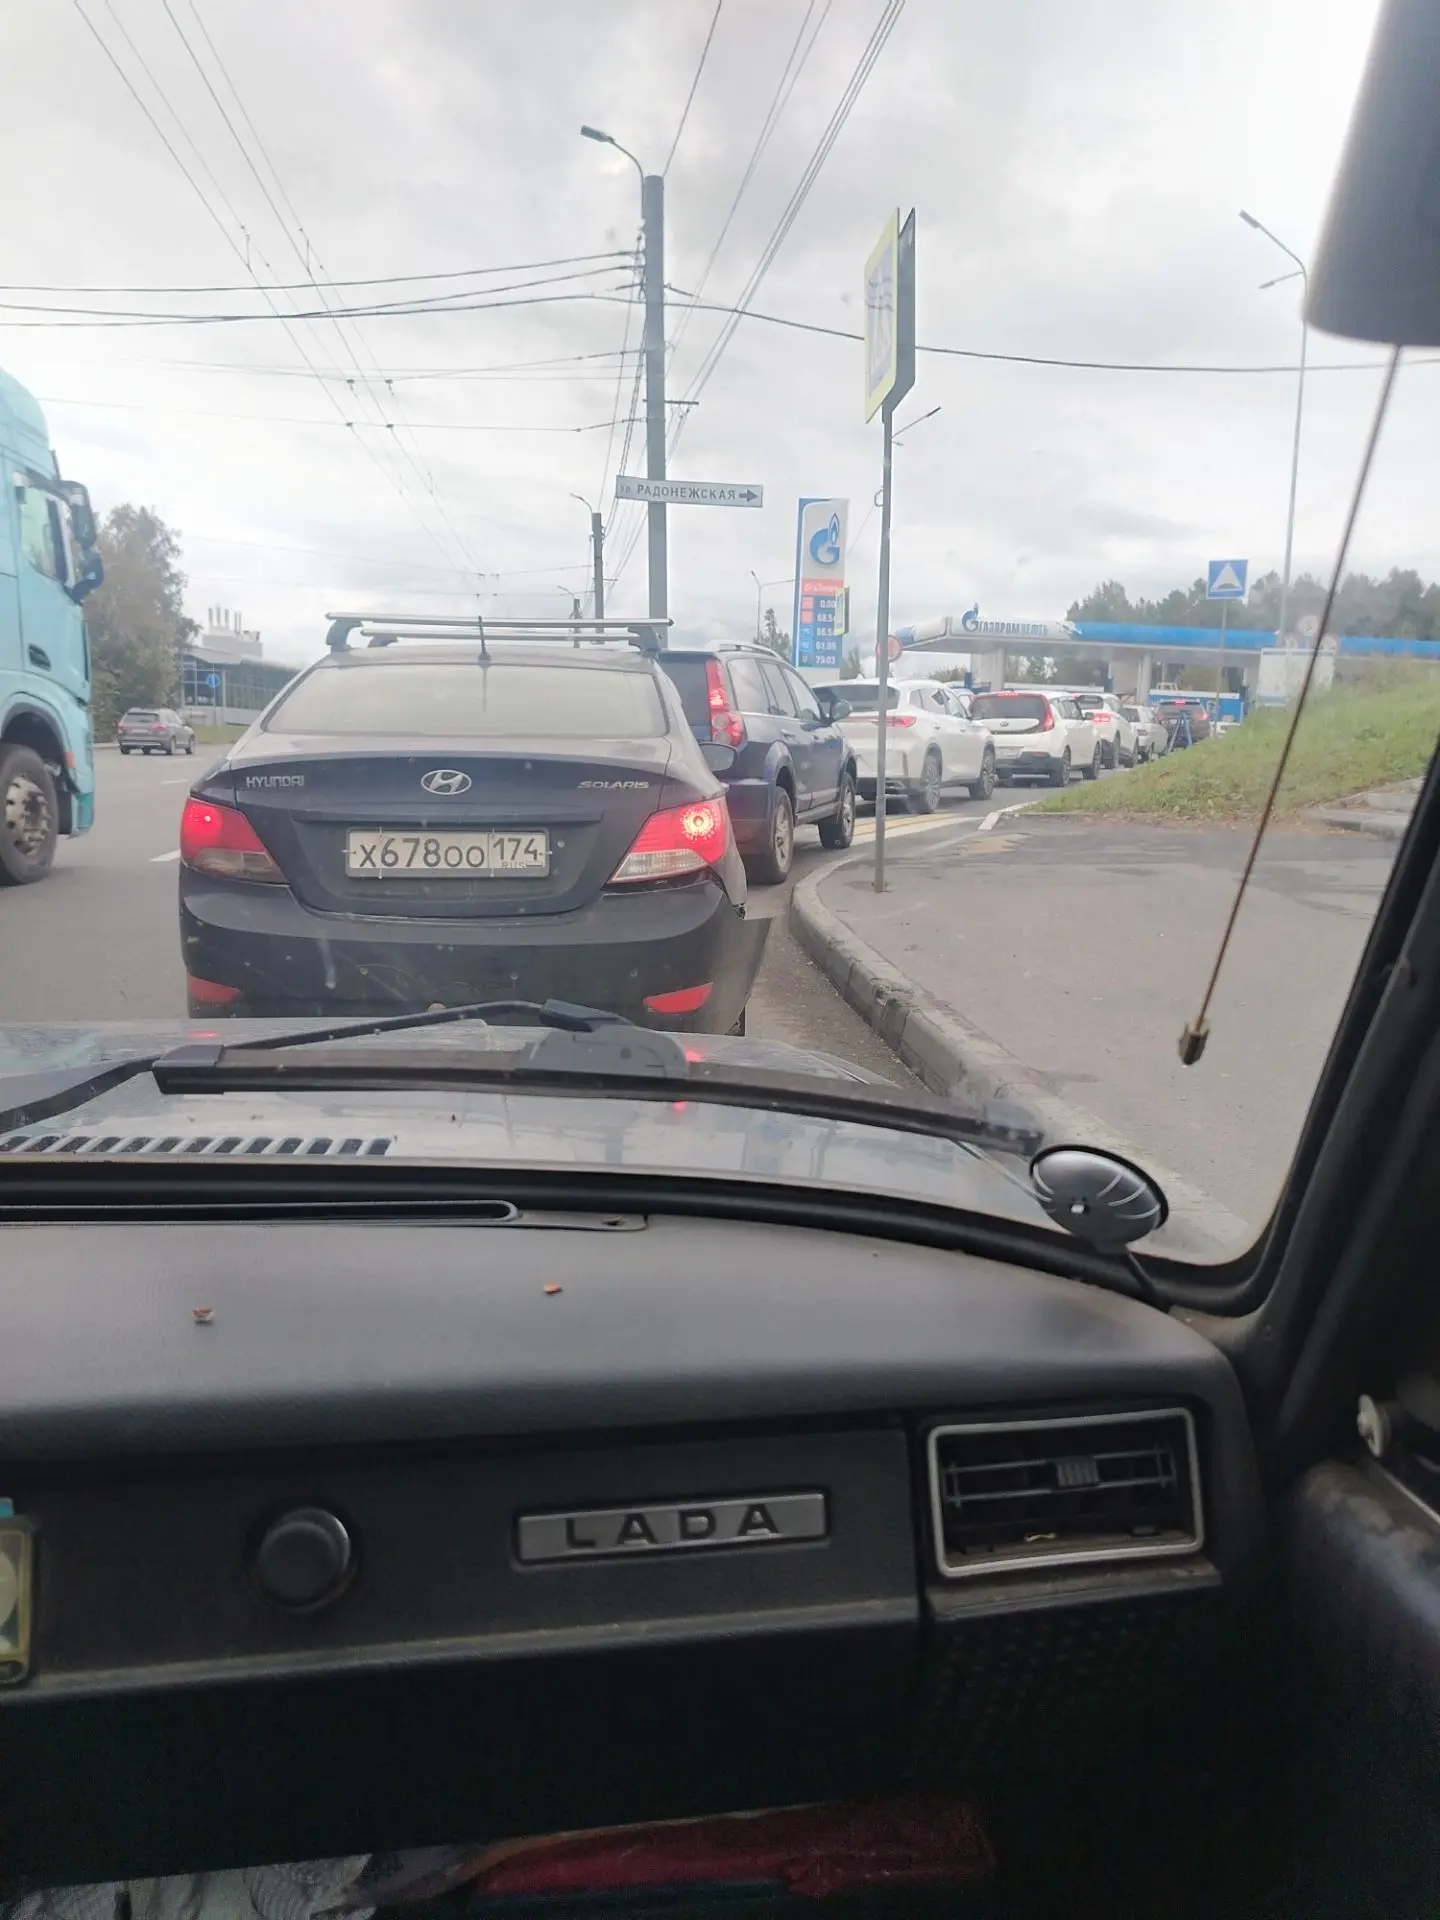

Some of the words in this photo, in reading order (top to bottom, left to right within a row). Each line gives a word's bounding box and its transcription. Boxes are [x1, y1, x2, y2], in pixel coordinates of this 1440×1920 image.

[637, 484, 736, 500] РАДОНЕЖСКАЯ
[246, 775, 304, 788] HYUNDAI
[577, 780, 650, 789] SOLARIS
[492, 838, 538, 861] 174
[565, 1503, 779, 1549] LADA
